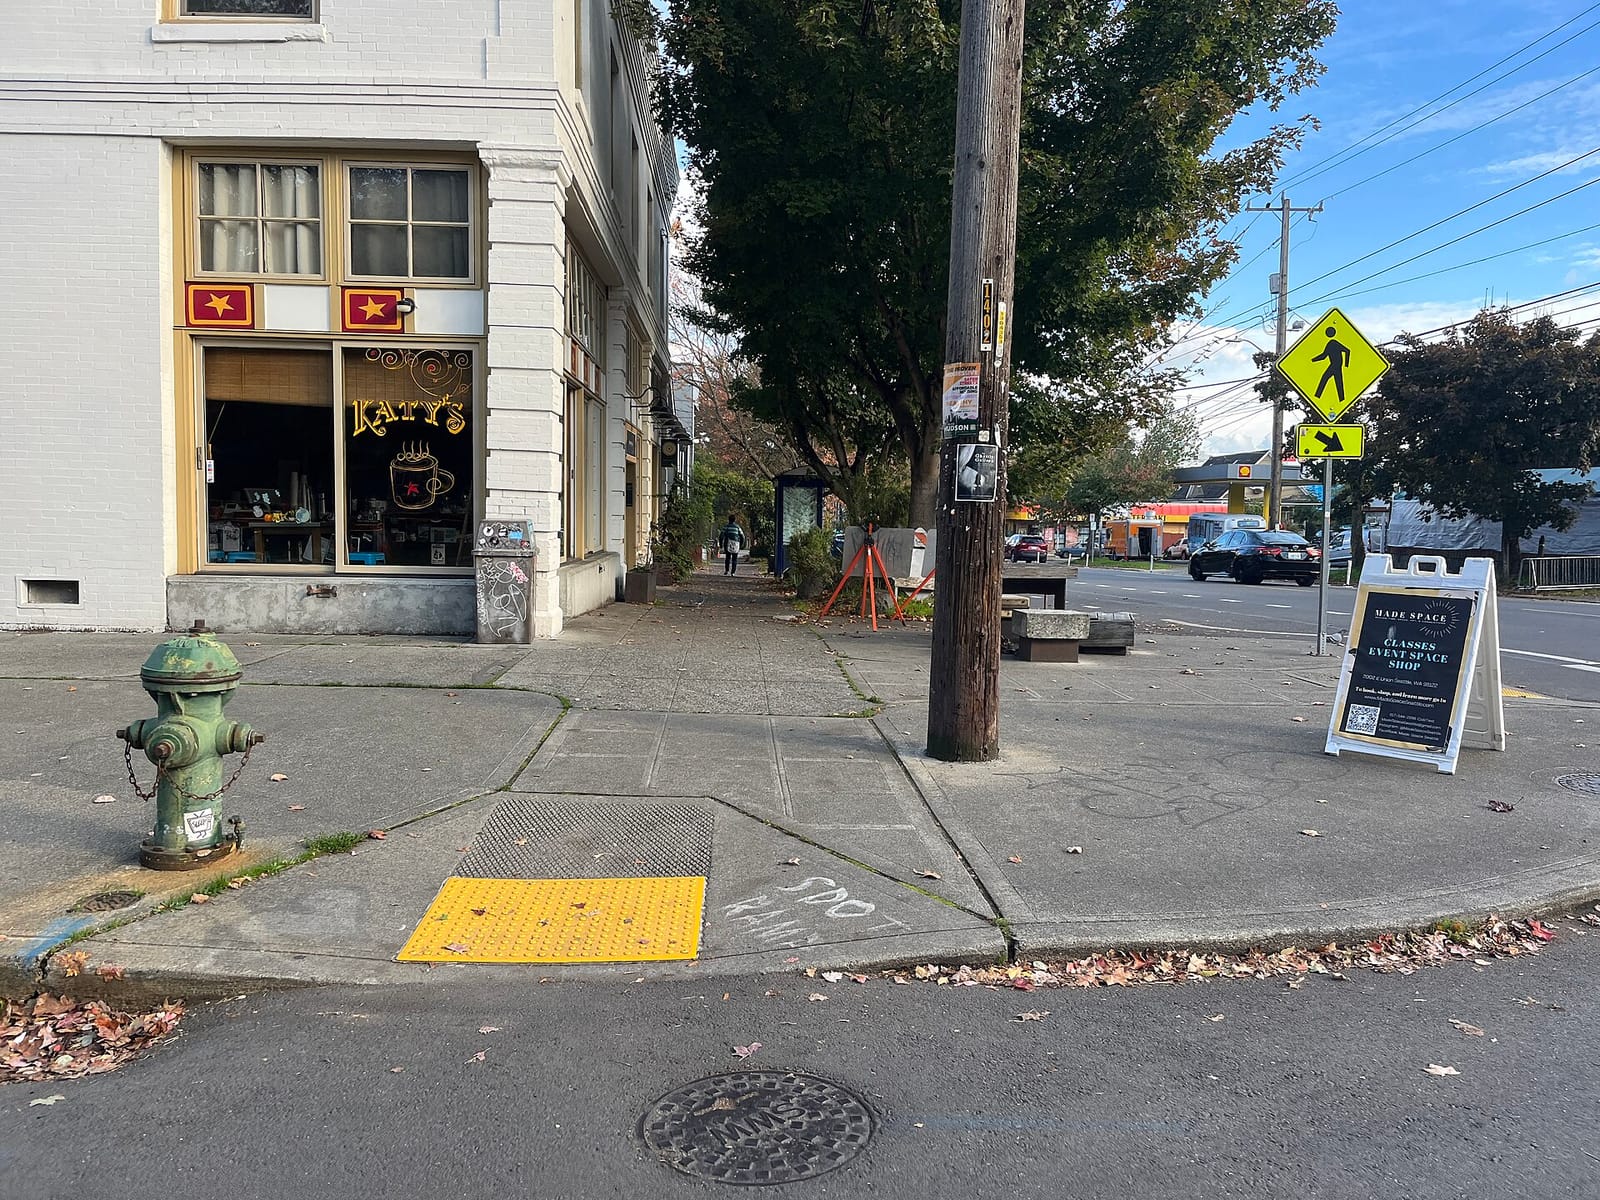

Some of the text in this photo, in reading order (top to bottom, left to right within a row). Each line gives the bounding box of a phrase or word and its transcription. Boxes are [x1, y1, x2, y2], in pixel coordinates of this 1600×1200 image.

[352, 394, 466, 437] KATY'S
[1375, 609, 1406, 618] MADE
[1409, 612, 1447, 623] SPACE
[1384, 638, 1437, 651] CLASSES
[1368, 647, 1448, 664] EVENT SPACE
[1388, 659, 1421, 671] SHOP
